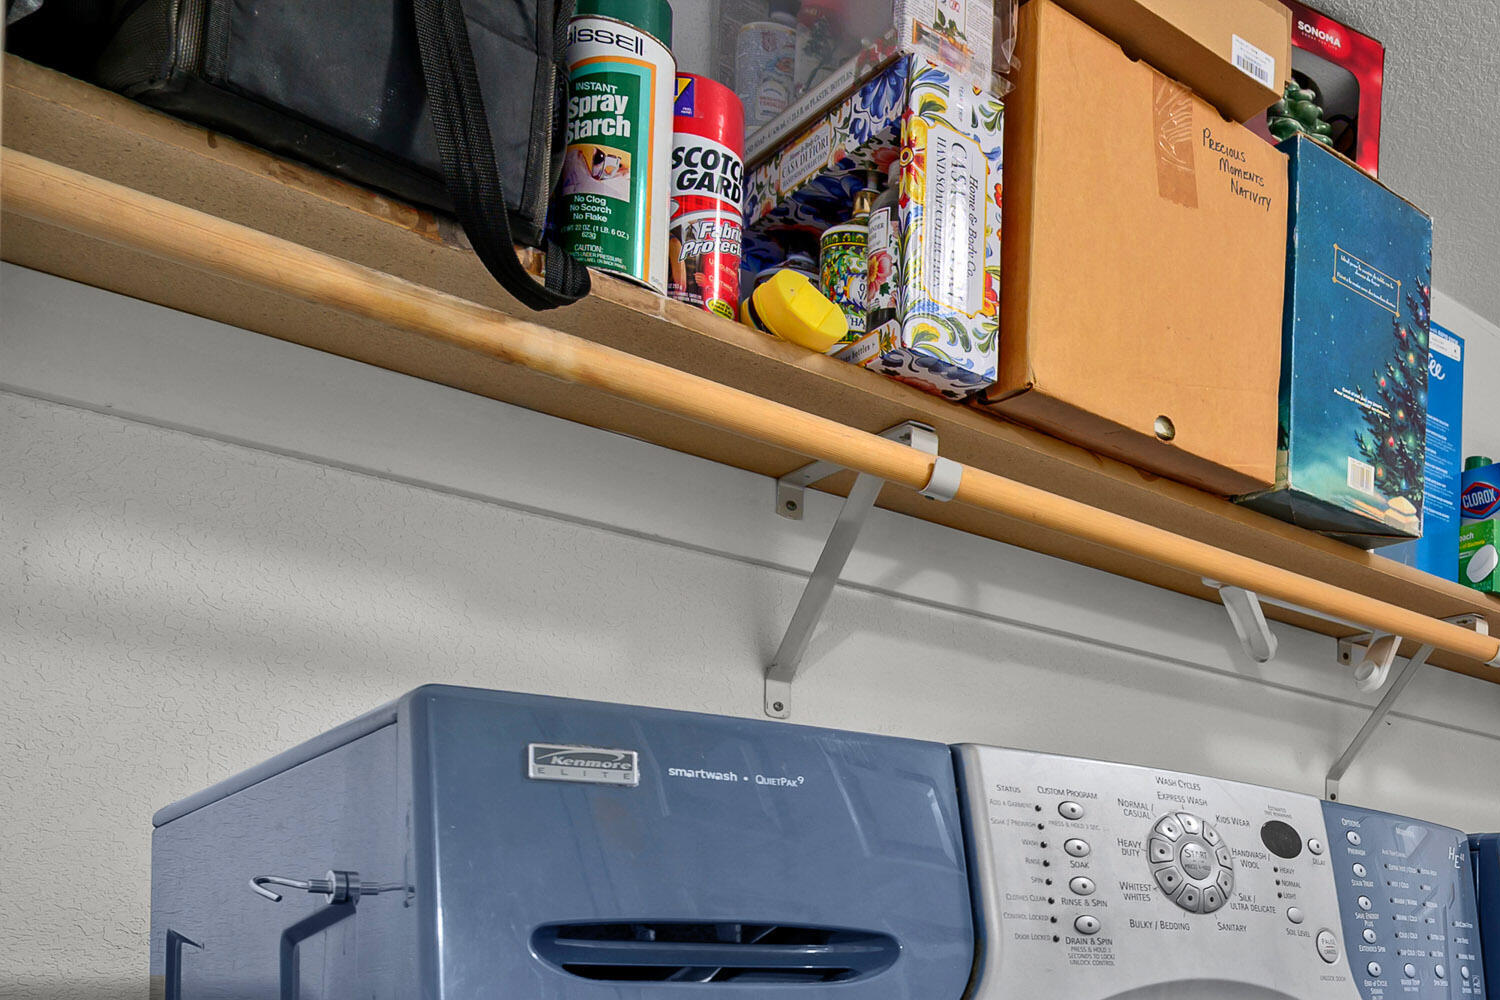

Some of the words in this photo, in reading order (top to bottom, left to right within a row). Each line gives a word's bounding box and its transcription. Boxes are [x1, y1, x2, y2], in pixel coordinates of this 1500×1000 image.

[1297, 20, 1341, 48] SONOMA
[576, 82, 618, 94] INSTANT
[568, 94, 629, 119] Spray
[935, 135, 947, 174] HAND
[676, 169, 741, 204] GARD
[968, 174, 978, 211] Home
[574, 195, 585, 203] No
[586, 195, 607, 207] Clog
[570, 203, 580, 212] No
[580, 204, 612, 215] Scorch
[573, 212, 584, 220] No
[585, 212, 608, 223] Flake
[581, 231, 597, 240] 623g
[1462, 488, 1496, 508] CLOROX
[551, 754, 632, 771] Kenmore
[537, 766, 632, 780] ELITE
[668, 766, 737, 782] smartwash
[1155, 776, 1177, 787] WASH
[1178, 780, 1201, 791] CYCLES
[1037, 786, 1065, 797] CUSTOM
[1066, 789, 1098, 800] PROGRAM
[1157, 791, 1186, 804] EXPRESS
[1187, 795, 1208, 806] WASH
[1117, 798, 1149, 810] NORMAL
[1123, 809, 1151, 819] CASUAL
[1215, 814, 1231, 824] KIDS
[1231, 816, 1250, 827] WEAR
[1117, 838, 1142, 848] HEAVY
[1121, 848, 1140, 857] DUTY
[1231, 848, 1267, 859] HANDWASH
[1070, 860, 1090, 869] SOAK
[1241, 859, 1260, 870] WOOL
[1119, 881, 1152, 892] WHITEST
[1061, 897, 1083, 907] RINSE
[1091, 898, 1108, 908] SPIN
[1123, 893, 1151, 902] WHITES
[1238, 892, 1252, 902] SILK
[1230, 902, 1249, 911] ULTRA
[1250, 904, 1277, 914] DELICATE
[1129, 918, 1153, 929] BULKY
[1160, 920, 1190, 931] BEDDING
[1217, 922, 1247, 932] SANITARY
[1065, 936, 1088, 946] DRAIN
[1097, 937, 1113, 947] SPIN
